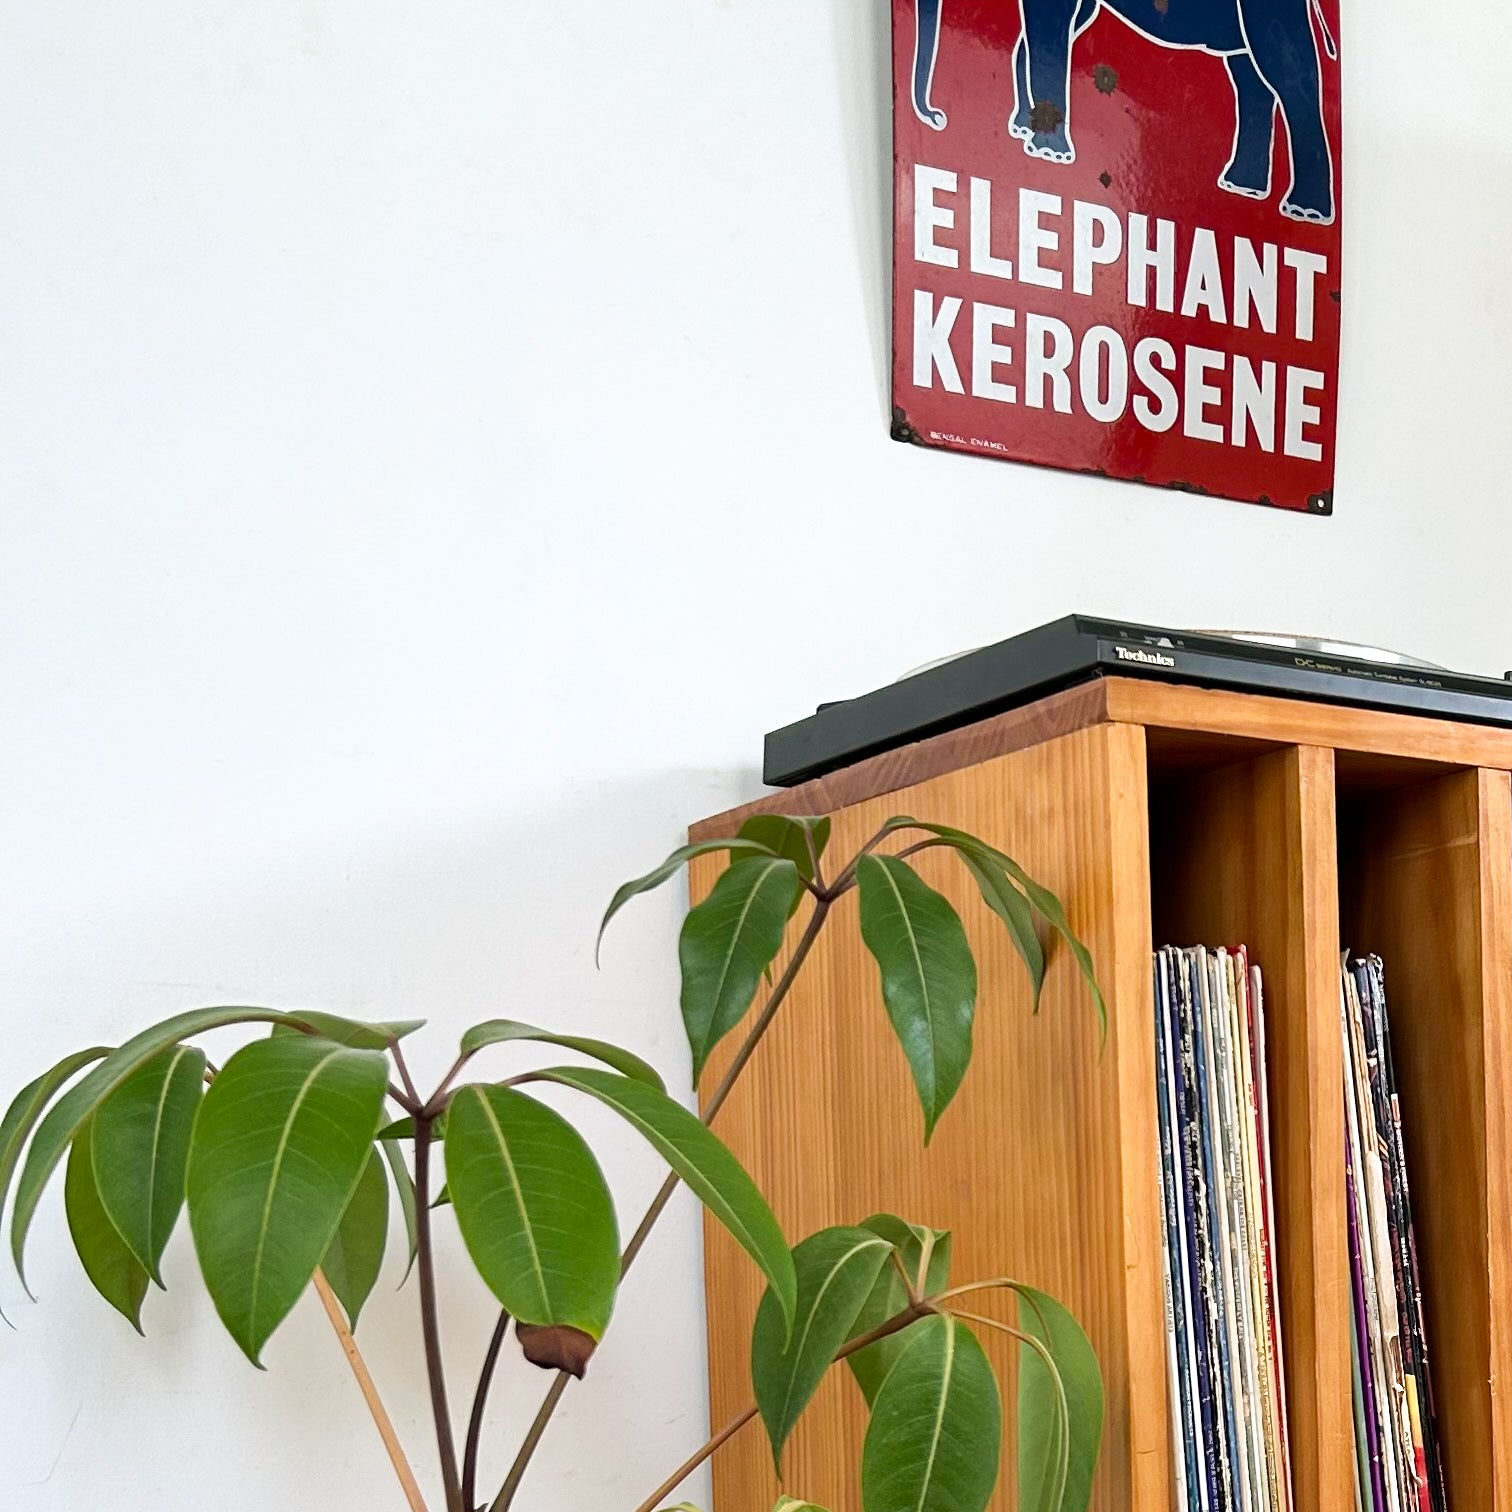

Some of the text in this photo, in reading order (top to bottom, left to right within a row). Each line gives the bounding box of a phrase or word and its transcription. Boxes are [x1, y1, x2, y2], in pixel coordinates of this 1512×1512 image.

[914, 163, 1328, 342] ELEPHANT
[912, 289, 1326, 463] KEROSENE
[1115, 646, 1175, 667] Technics
